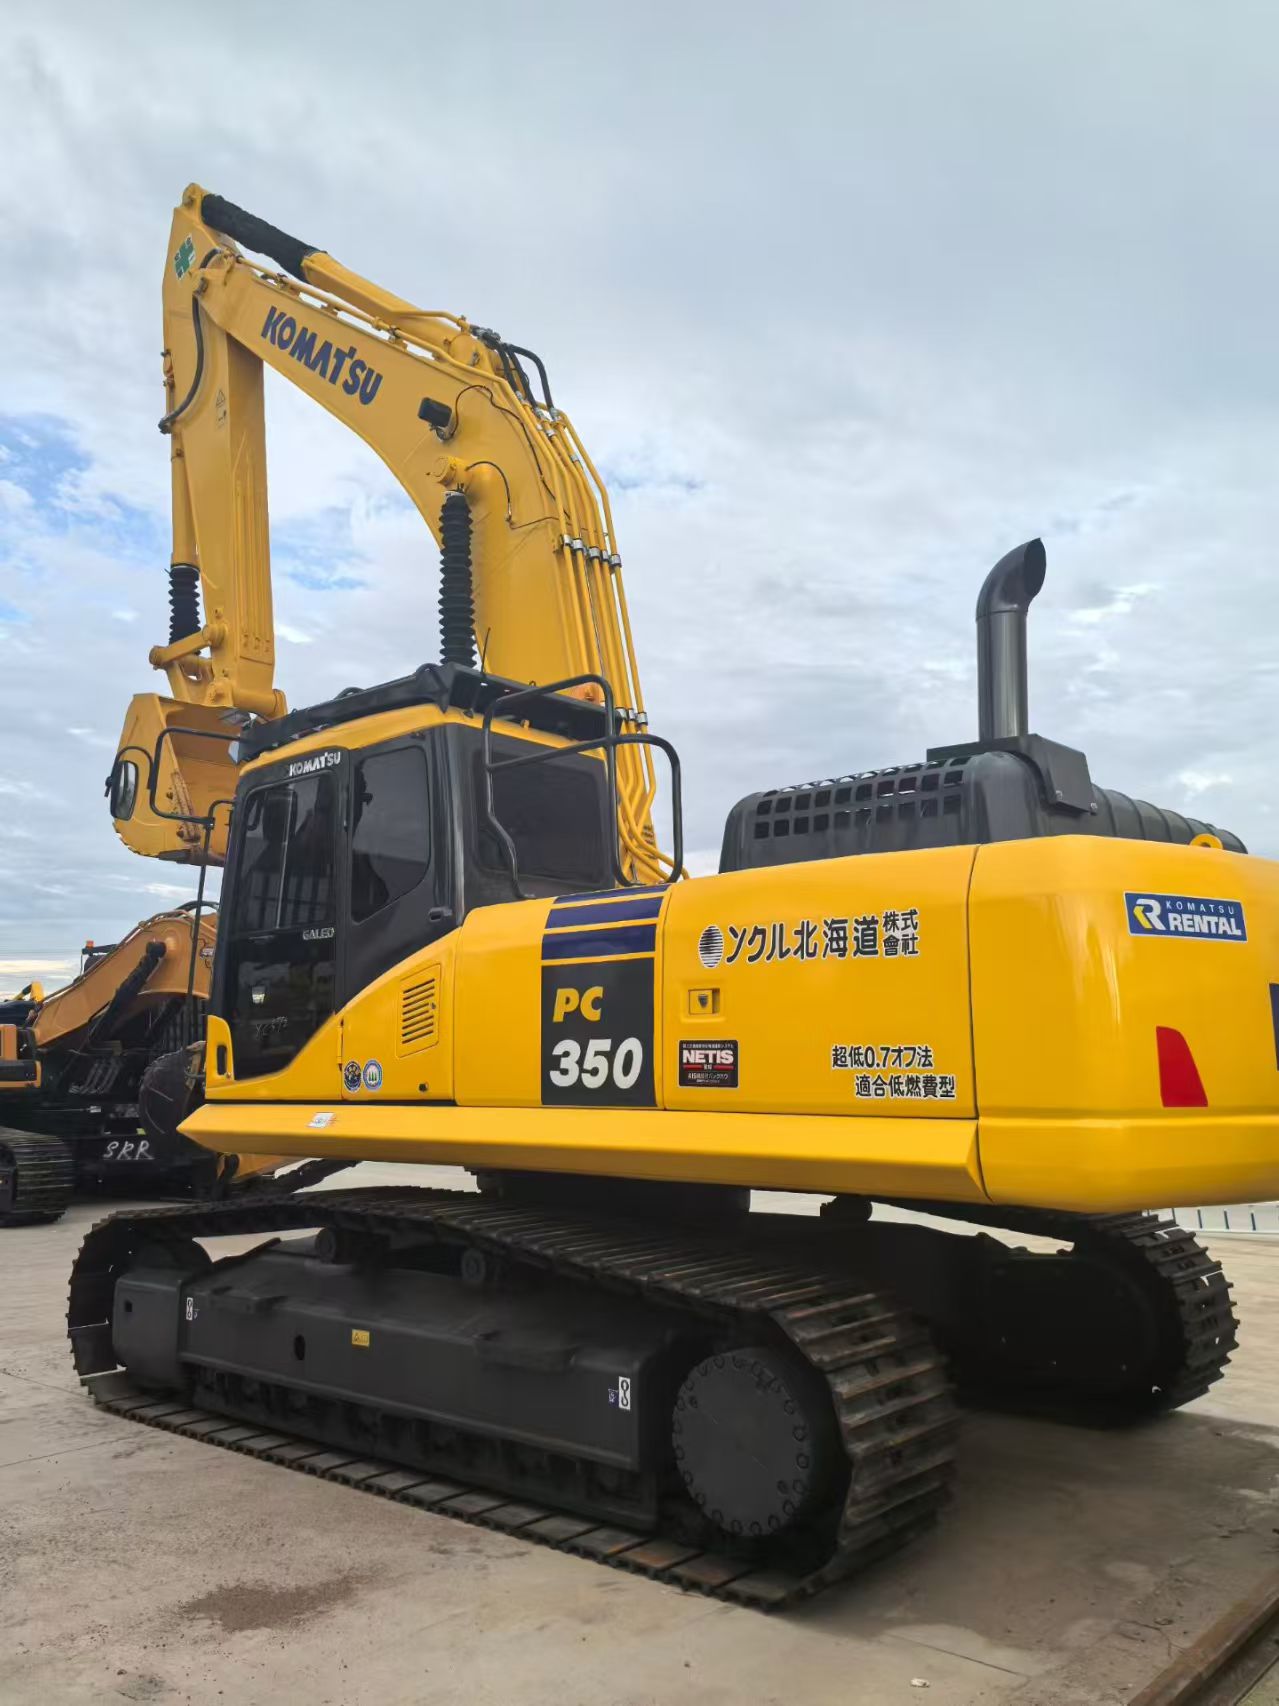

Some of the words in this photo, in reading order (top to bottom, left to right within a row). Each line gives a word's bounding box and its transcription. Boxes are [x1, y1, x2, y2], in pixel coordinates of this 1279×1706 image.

[261, 305, 383, 405] KOMATSU
[289, 751, 341, 777] KOMATSU
[1166, 901, 1234, 915] KOMATSU
[302, 927, 335, 940] GALEO
[1167, 912, 1242, 935] RENTAL
[553, 985, 604, 1022] PC
[549, 1037, 643, 1089] 350
[683, 1050, 734, 1065] NETIS
[855, 1074, 955, 1098] 適合低燃費型
